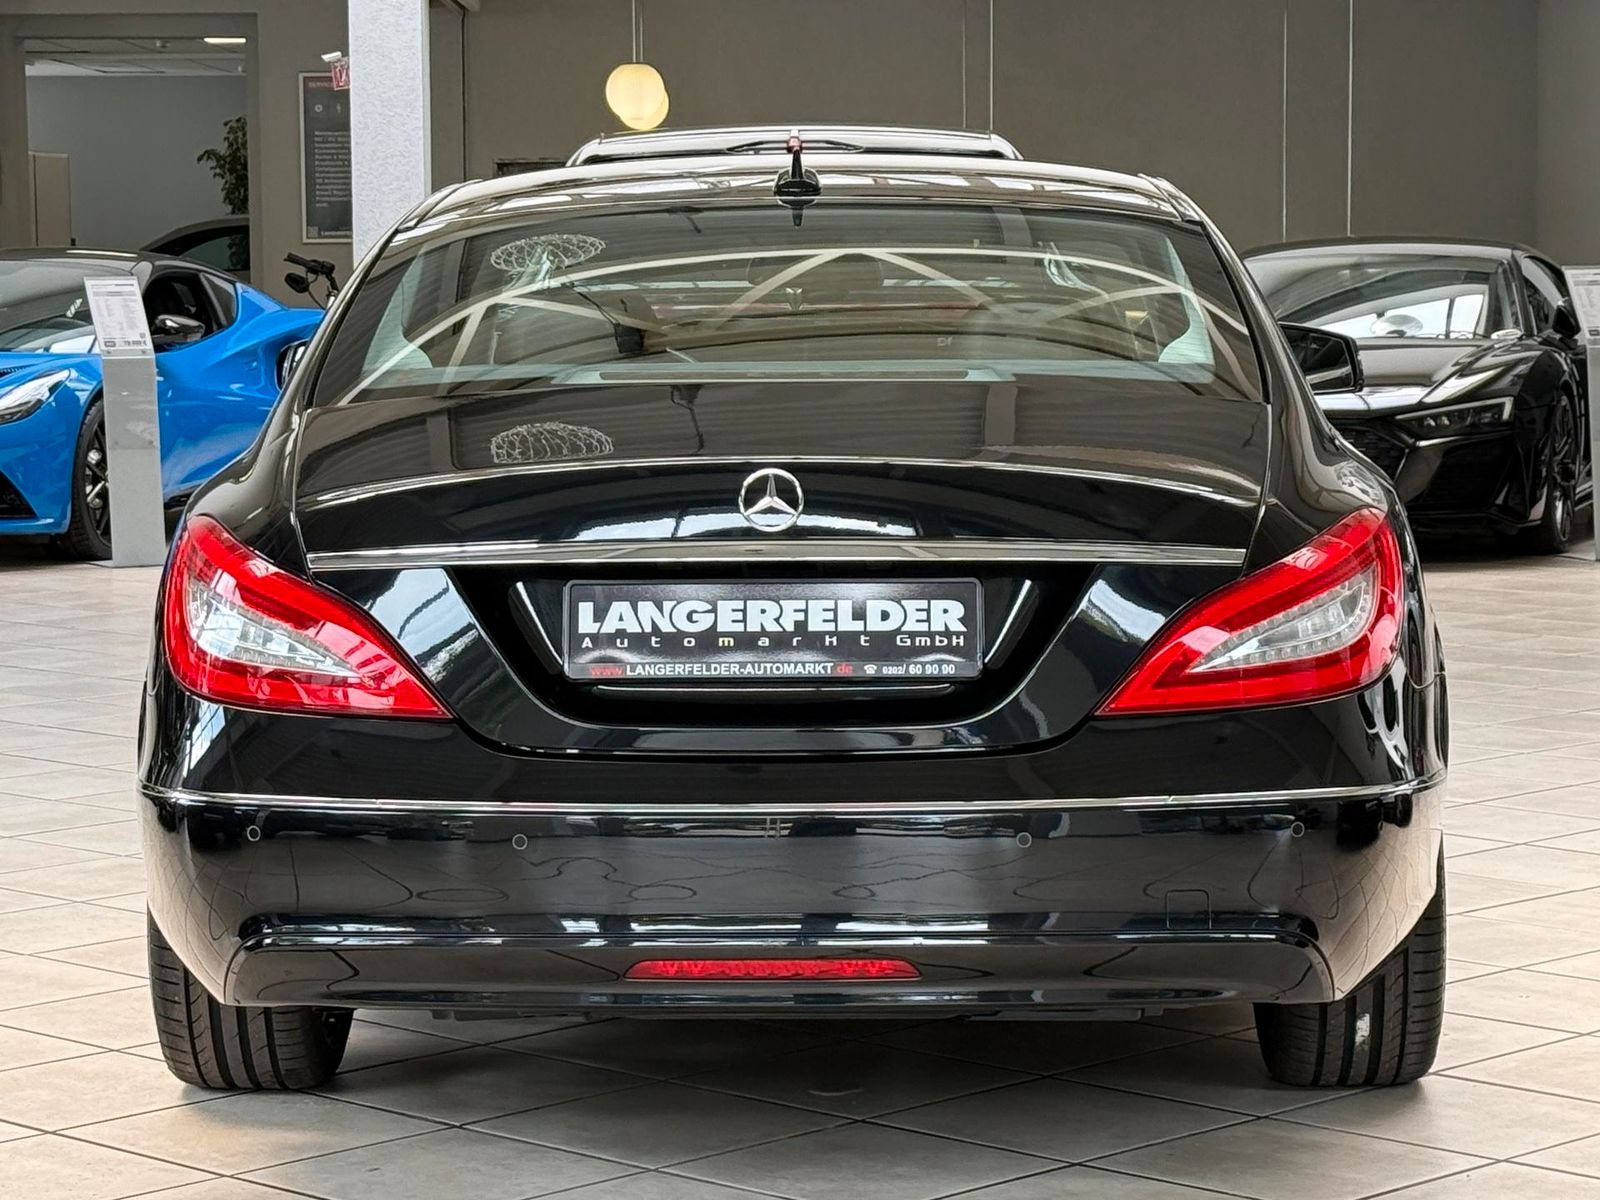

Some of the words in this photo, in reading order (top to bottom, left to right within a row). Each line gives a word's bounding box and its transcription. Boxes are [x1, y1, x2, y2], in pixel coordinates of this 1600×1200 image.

[578, 599, 968, 634] LANGERFELDER
[896, 634, 965, 647] GmbH
[909, 664, 922, 674] 60
[925, 664, 939, 674] 90
[942, 664, 955, 674] 90
